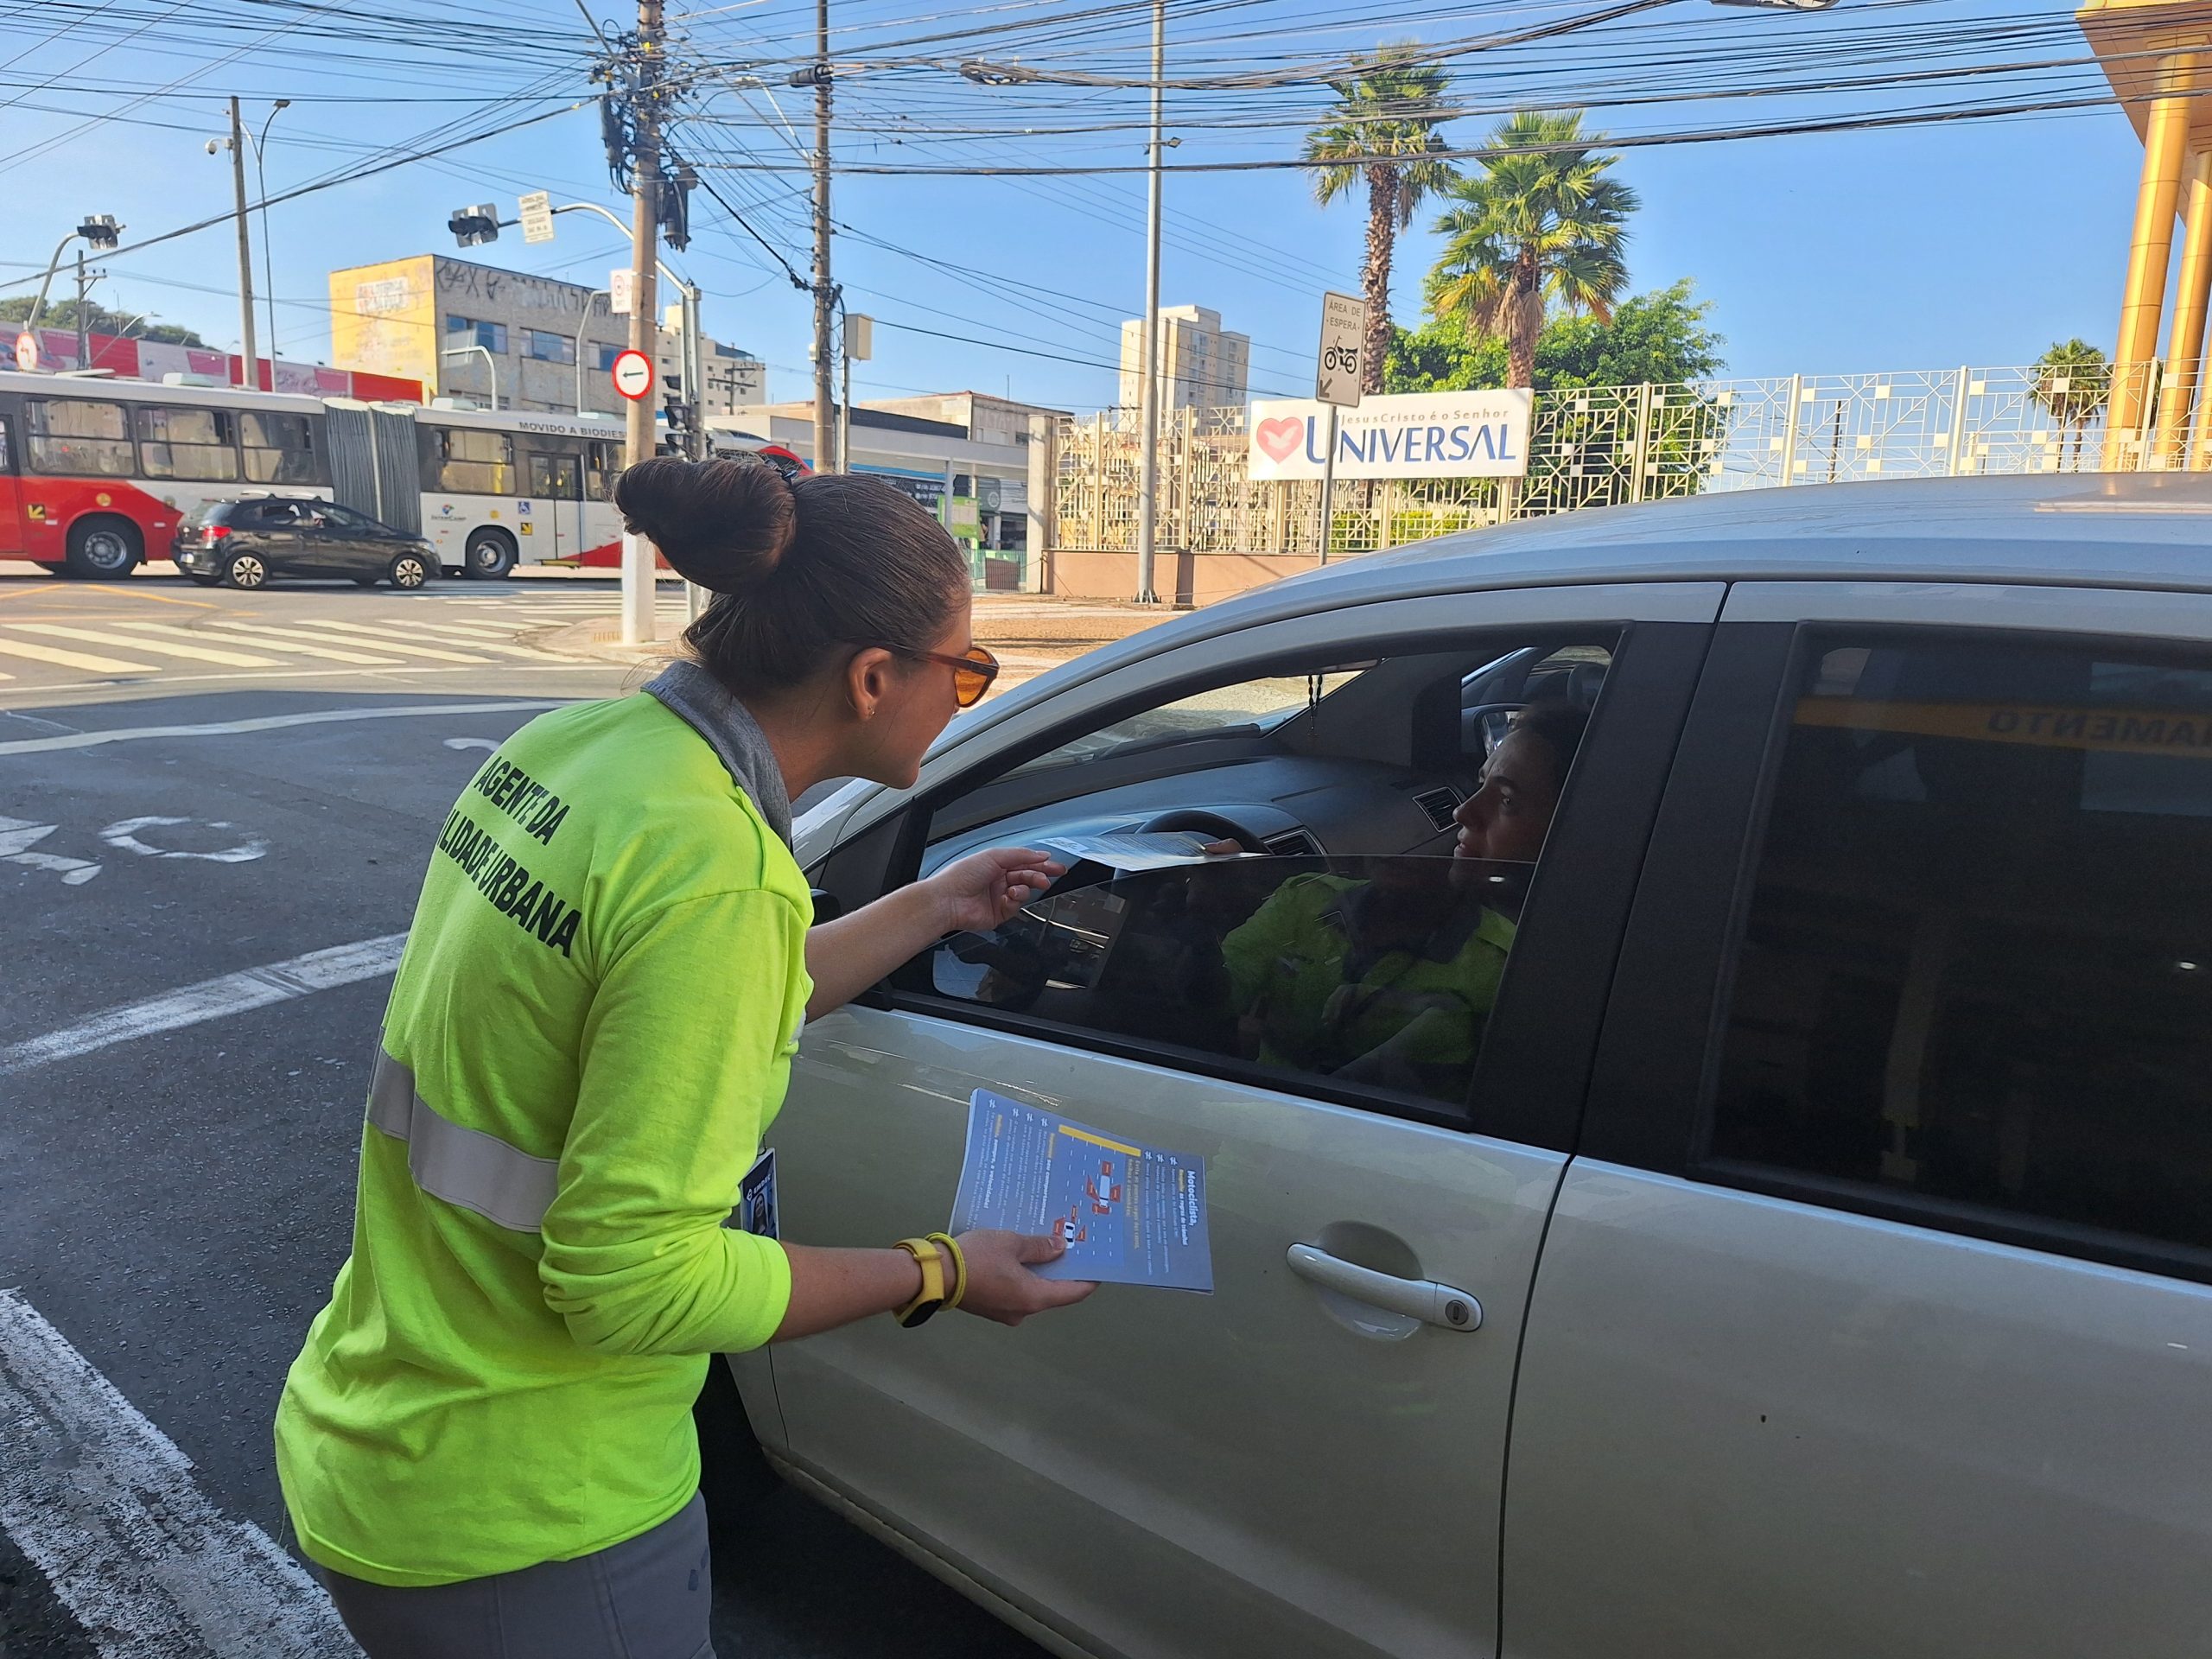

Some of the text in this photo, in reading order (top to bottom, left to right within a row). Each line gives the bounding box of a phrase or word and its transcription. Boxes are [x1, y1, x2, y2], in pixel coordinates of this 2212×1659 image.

[1329, 299, 1361, 317] ÁREA DE
[1330, 316, 1357, 332] ESPERA
[518, 422, 566, 433] MOVIDO
[580, 427, 626, 439] BIODIES
[1430, 409, 1437, 421] é
[1441, 412, 1449, 421] o
[1453, 408, 1510, 420] Senhor
[1306, 415, 1516, 464] UNIVERSAL
[525, 795, 570, 846] DA
[478, 849, 582, 958] URBANA
[1187, 1169, 1199, 1226] Motociclista,
